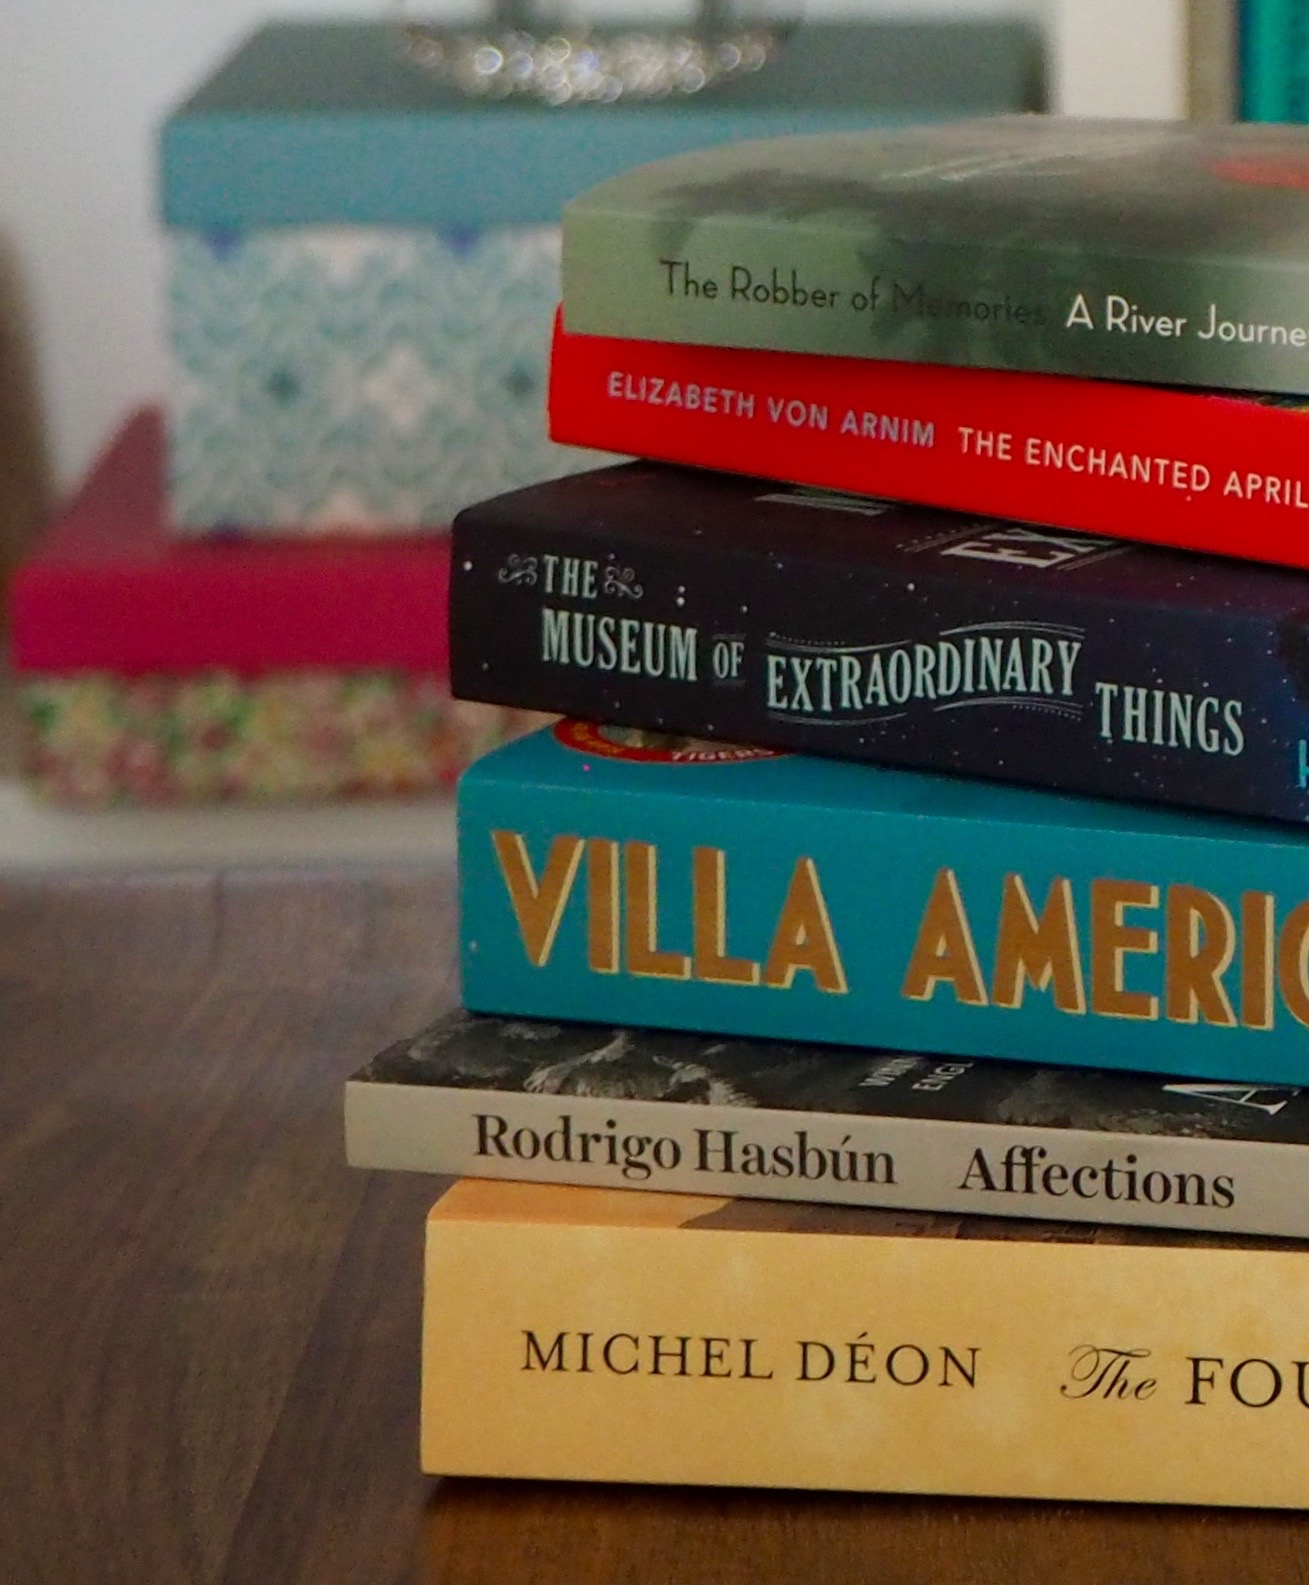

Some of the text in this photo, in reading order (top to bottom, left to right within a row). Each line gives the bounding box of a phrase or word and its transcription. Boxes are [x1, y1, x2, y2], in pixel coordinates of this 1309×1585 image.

[660, 258, 718, 300] The
[730, 265, 841, 309] Robber
[850, 274, 882, 312] of
[893, 282, 1048, 327] Memories
[1065, 293, 1095, 331] A
[1105, 294, 1189, 339] River
[607, 371, 1309, 510] ELIZABETH VON ARNIM THE ENCHANTED APRIL
[542, 553, 598, 601] THE
[541, 606, 1246, 756] MUSEUM OF EXTRAORDINARY THINGS
[490, 827, 850, 995] VILLA
[471, 1112, 1237, 1210] Rodrigo Hasbún Affections
[520, 1329, 776, 1382] MICHEL
[796, 1333, 983, 1390] DÉON
[1059, 1342, 1159, 1404] The
